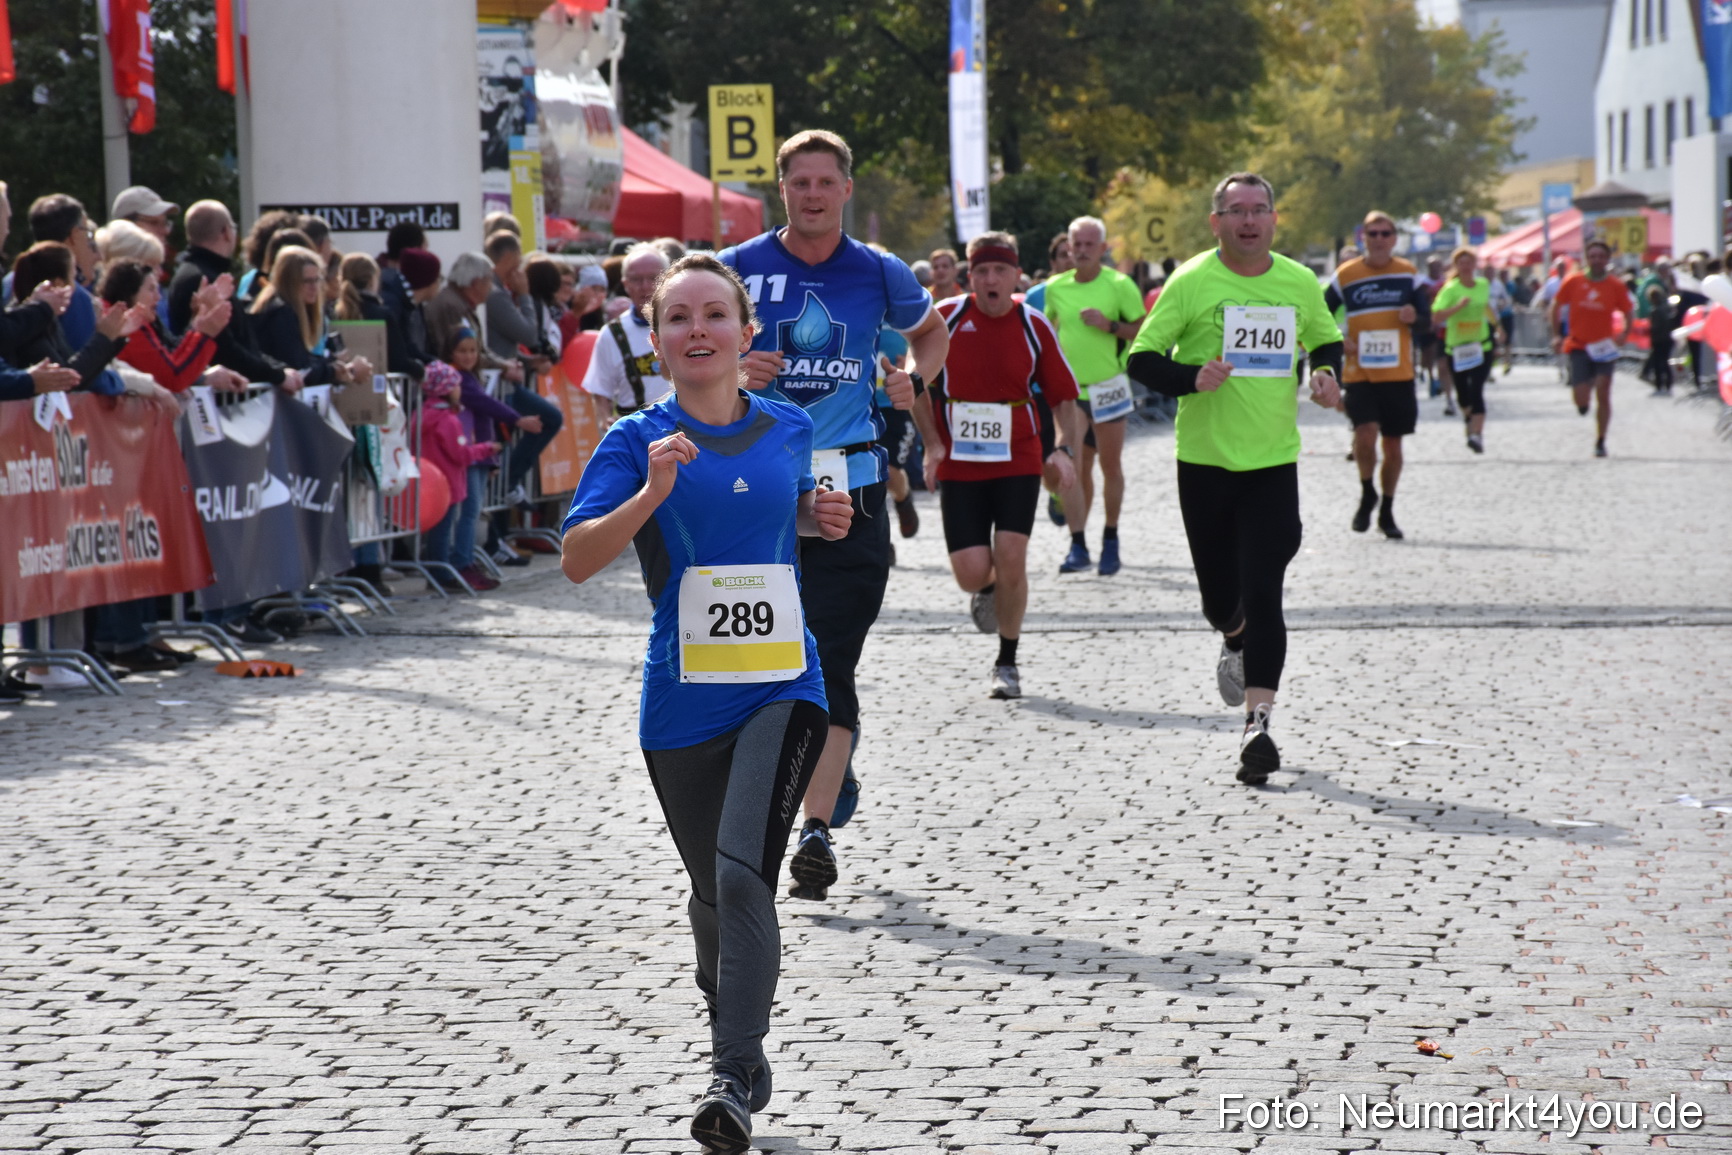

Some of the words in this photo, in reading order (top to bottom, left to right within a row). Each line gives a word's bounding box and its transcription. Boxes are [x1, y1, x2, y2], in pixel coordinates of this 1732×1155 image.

[716, 90, 765, 107] Block
[727, 115, 758, 160] B
[1146, 217, 1165, 244] C
[1629, 226, 1644, 244] D
[743, 274, 788, 303] 11
[1234, 327, 1286, 350] 2140
[1365, 342, 1393, 353] 2121
[784, 380, 831, 390] BASKETS
[1095, 386, 1127, 406] 2500
[960, 420, 1003, 440] 2158
[724, 575, 766, 587] BOCK
[708, 600, 775, 638] 289
